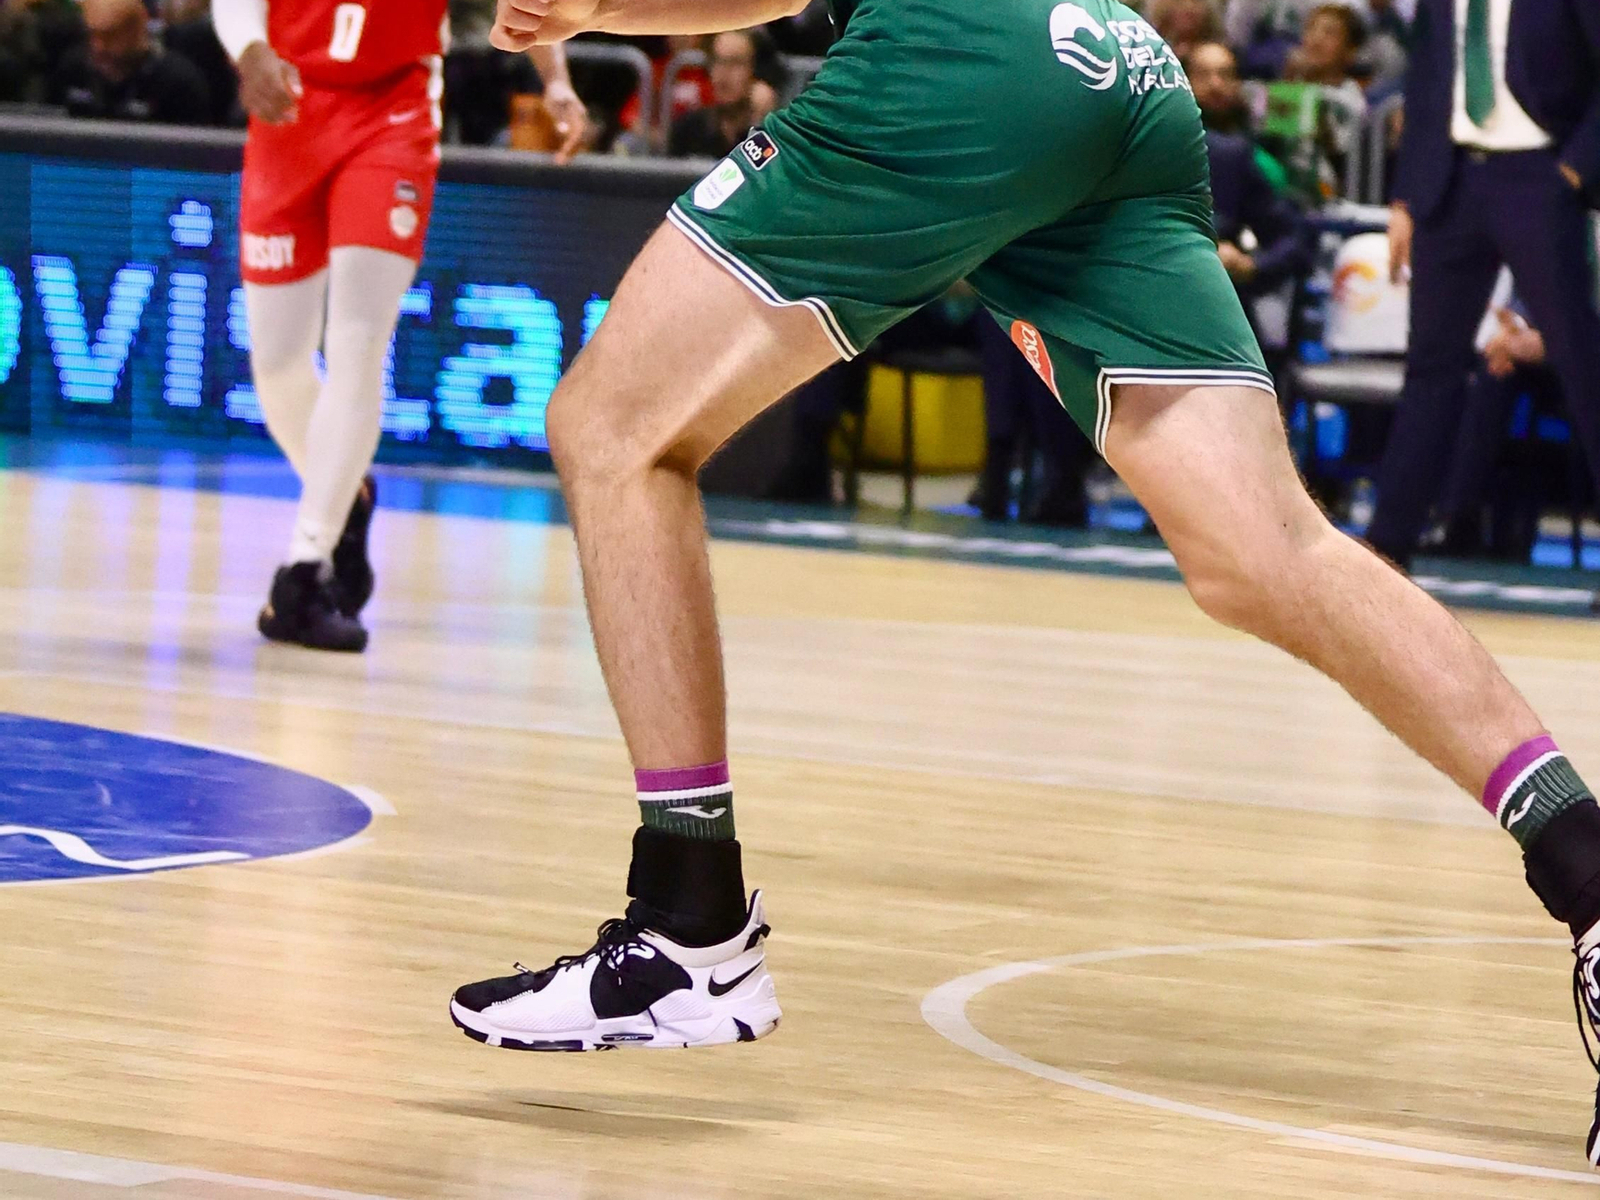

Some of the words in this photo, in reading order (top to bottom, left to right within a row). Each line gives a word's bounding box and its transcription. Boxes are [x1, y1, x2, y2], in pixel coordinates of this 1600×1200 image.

[328, 2, 366, 62] 0
[1119, 44, 1167, 69] DEL
[1127, 67, 1194, 96] MÁLA
[744, 139, 763, 161] acb
